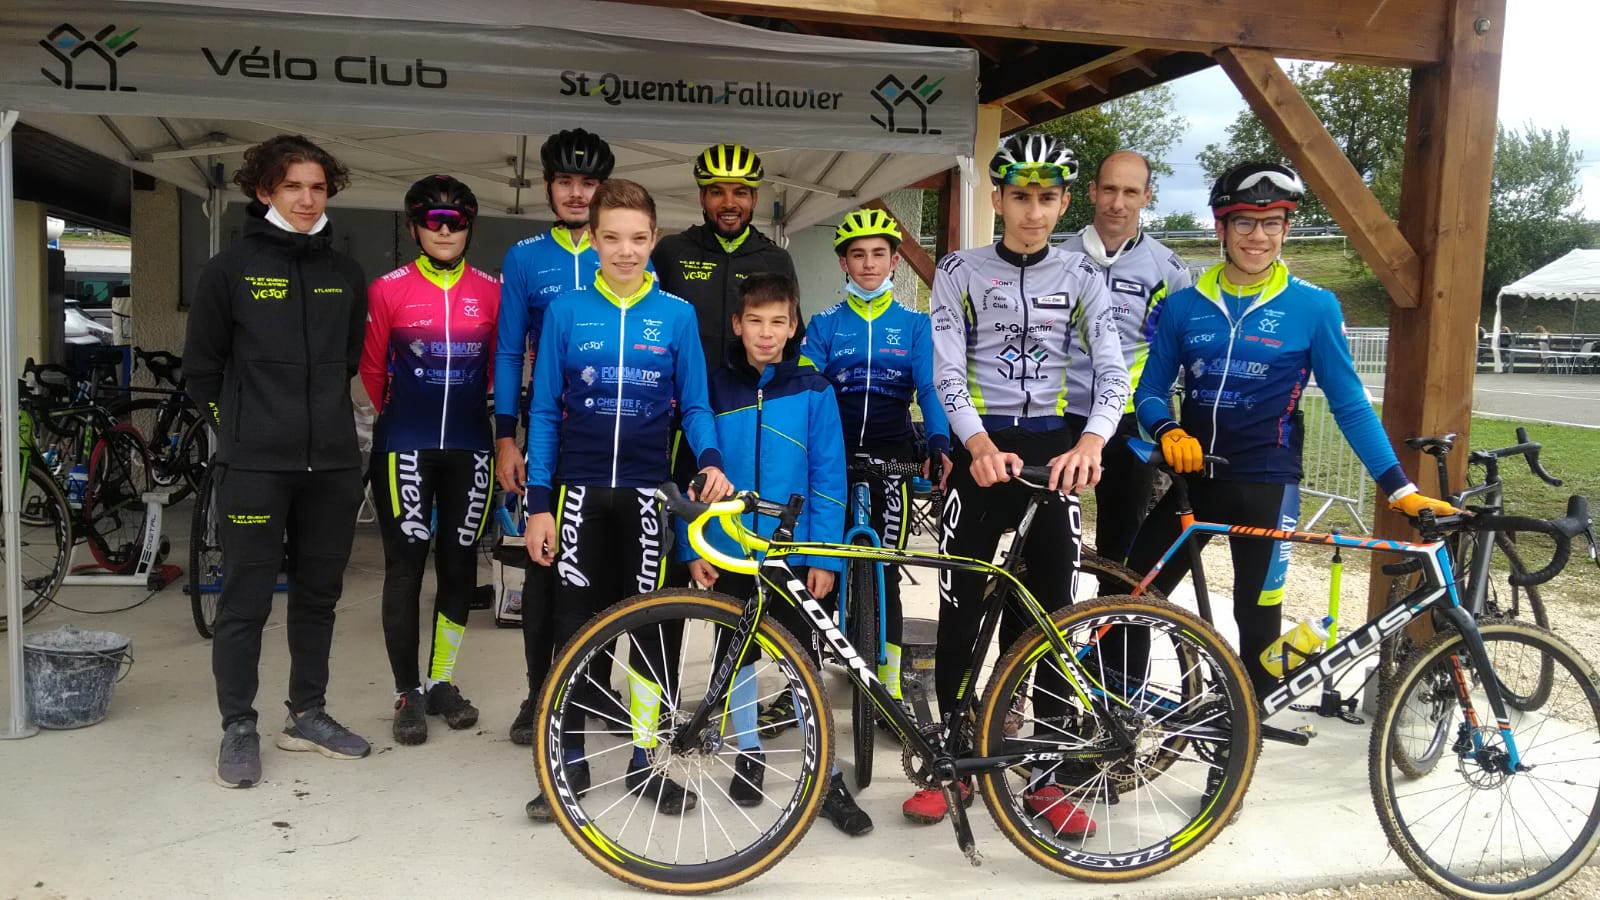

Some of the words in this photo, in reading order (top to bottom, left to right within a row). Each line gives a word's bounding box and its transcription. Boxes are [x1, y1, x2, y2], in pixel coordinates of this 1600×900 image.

[201, 45, 318, 81] Vélo
[334, 55, 448, 89] Club
[601, 73, 714, 106] Quentin
[724, 80, 844, 111] Fallavier
[250, 288, 289, 300] VCSQF
[705, 598, 758, 706] LOOK
[786, 578, 881, 689] LOOK
[1060, 652, 1098, 701] LOOK
[1263, 604, 1412, 715] FOCUS
